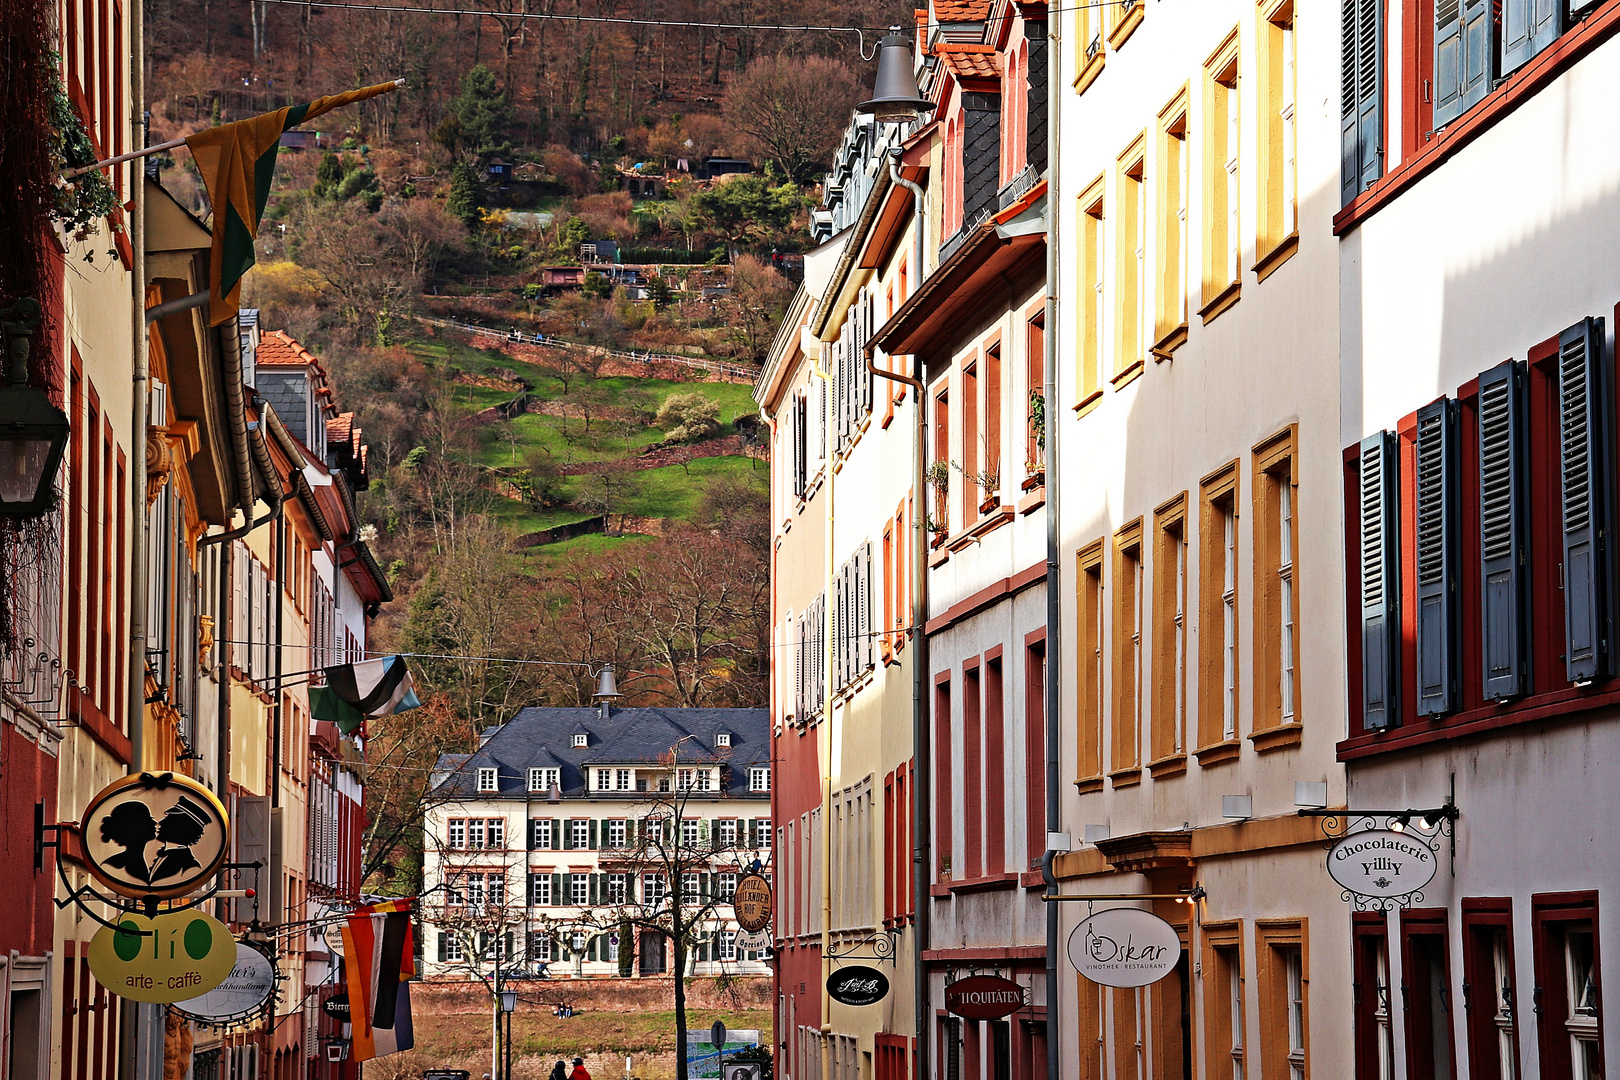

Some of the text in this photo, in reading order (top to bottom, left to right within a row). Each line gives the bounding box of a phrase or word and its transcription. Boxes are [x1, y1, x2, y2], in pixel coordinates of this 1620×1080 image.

[1335, 837, 1429, 862] Chocolaterie
[742, 879, 762, 891] HOTEL
[736, 904, 770, 930] RESTAURANT
[744, 903, 756, 915] HOF
[1090, 933, 1167, 963] Oskar
[126, 974, 153, 989] arte
[167, 971, 202, 989] caffè
[947, 988, 1020, 1006] TIQUITÄTEN
[326, 1001, 350, 1013] Bierg
